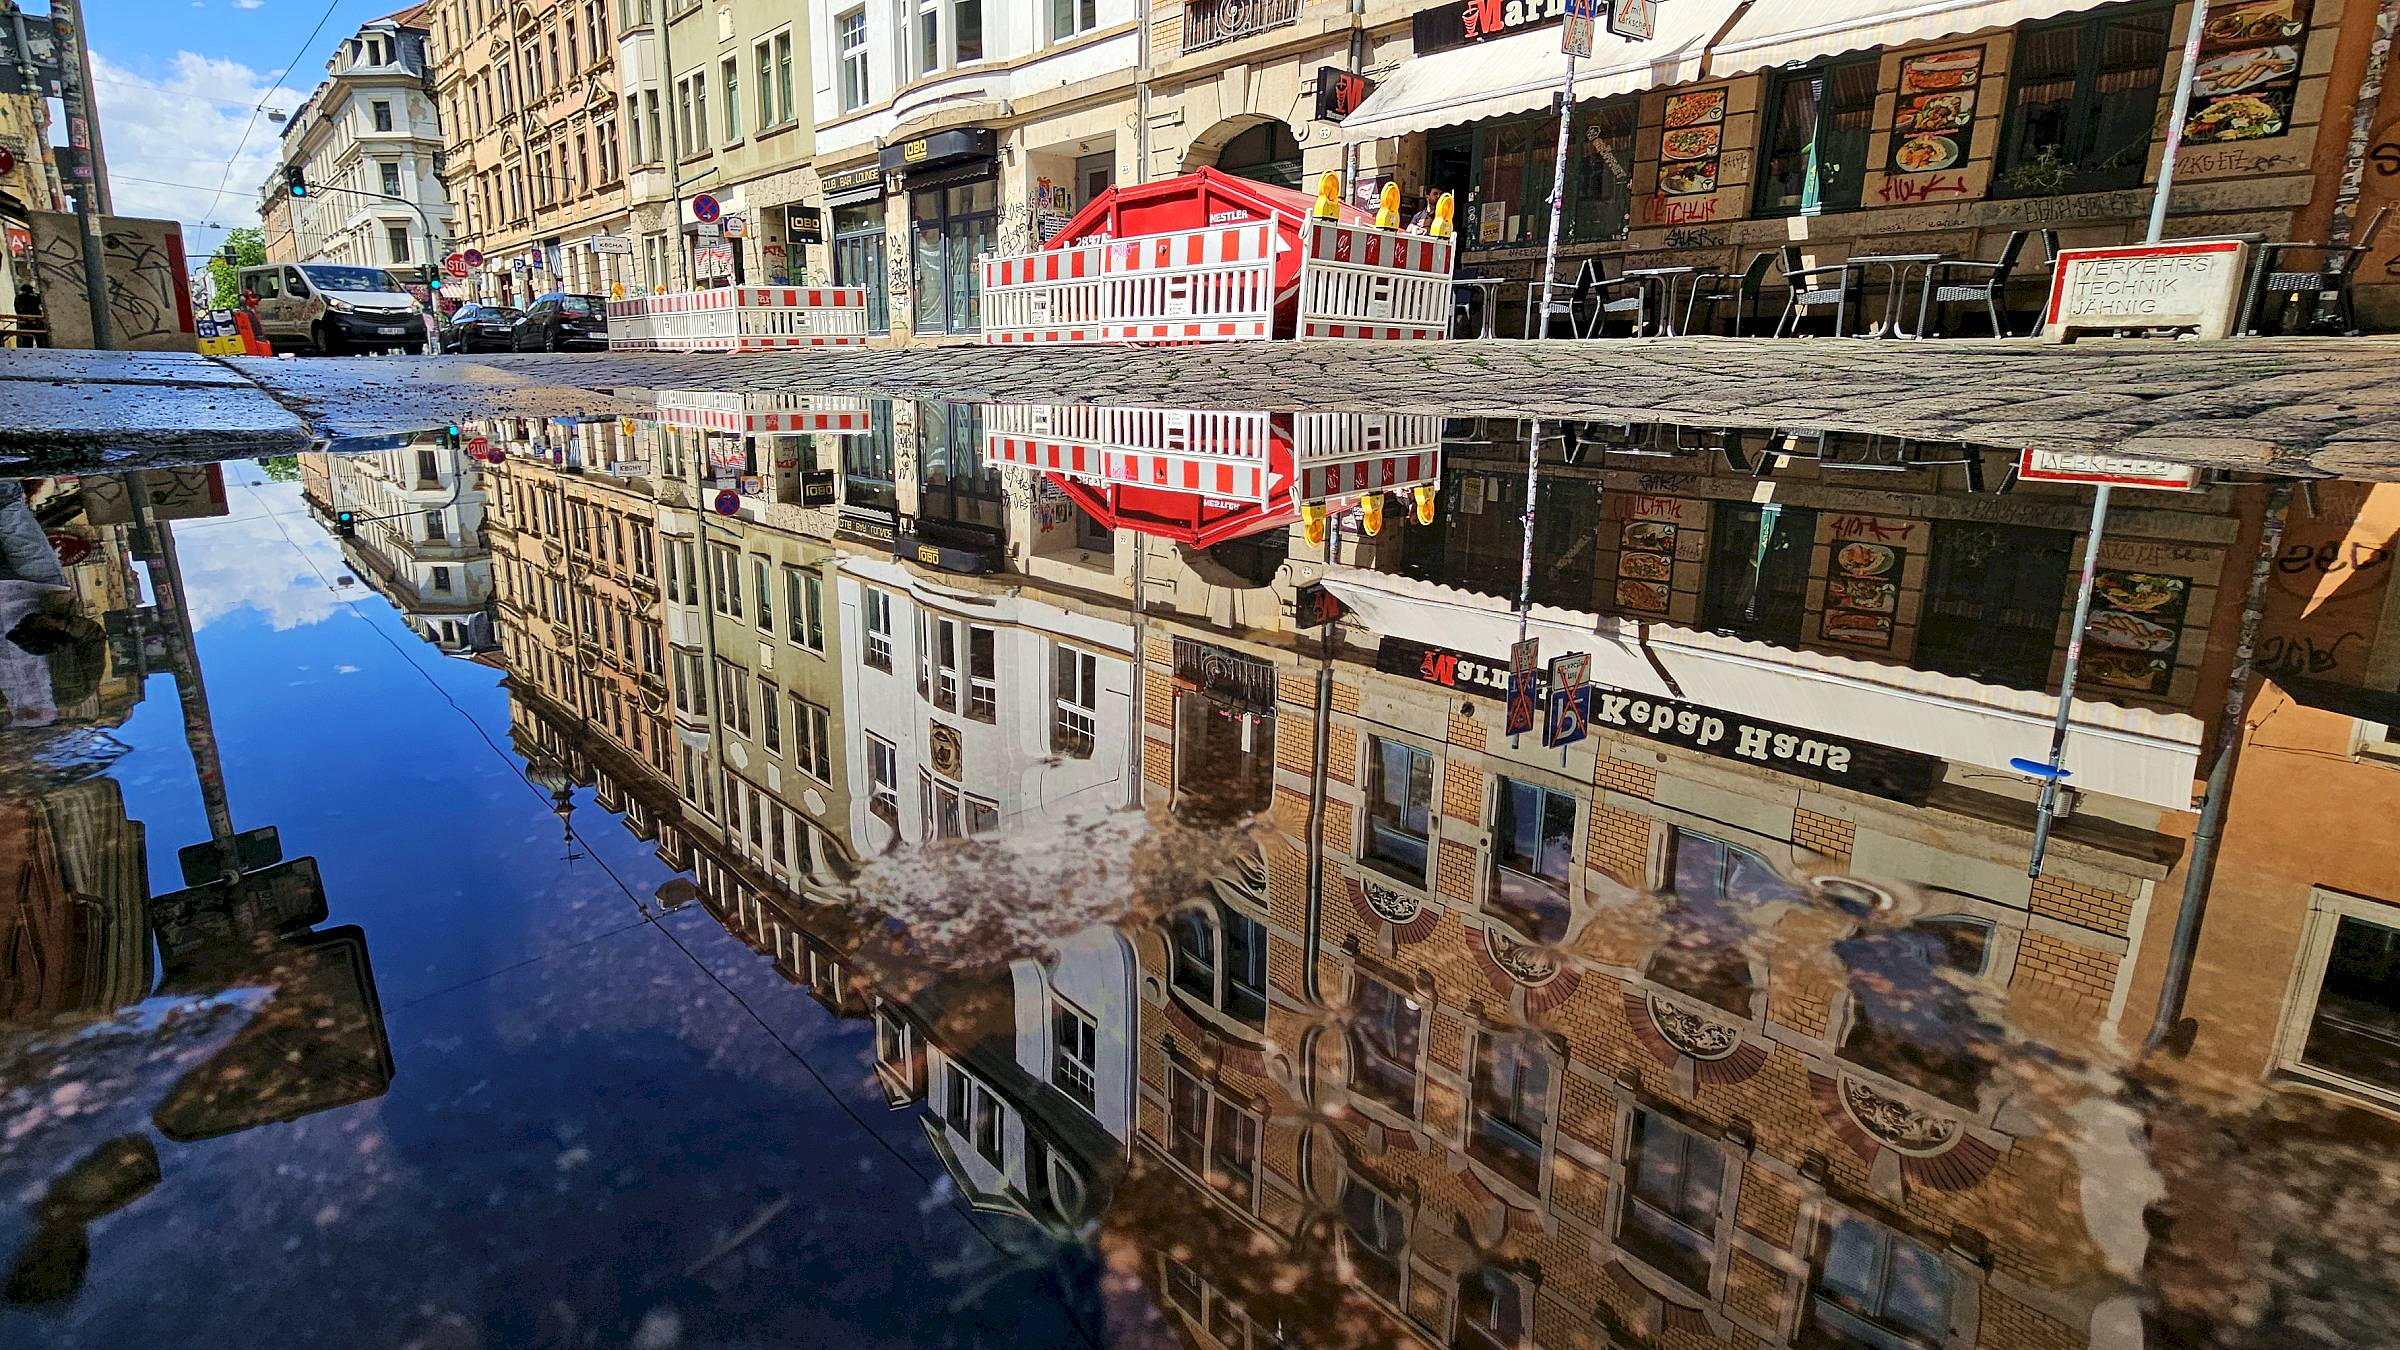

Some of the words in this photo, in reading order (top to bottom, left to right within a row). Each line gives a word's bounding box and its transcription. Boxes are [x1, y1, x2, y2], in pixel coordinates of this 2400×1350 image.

[904, 139, 927, 160] LOBO
[822, 180, 837, 191] CLUB
[839, 175, 852, 186] BAR
[855, 168, 880, 184] LOUNGE
[790, 216, 821, 231] LOBO
[1209, 209, 1249, 223] NESTLER
[447, 258, 467, 272] STO
[2080, 257, 2210, 277] VERKEHRS
[2077, 278, 2179, 296] TECHNIK
[2072, 299, 2156, 316] JÄHNIG
